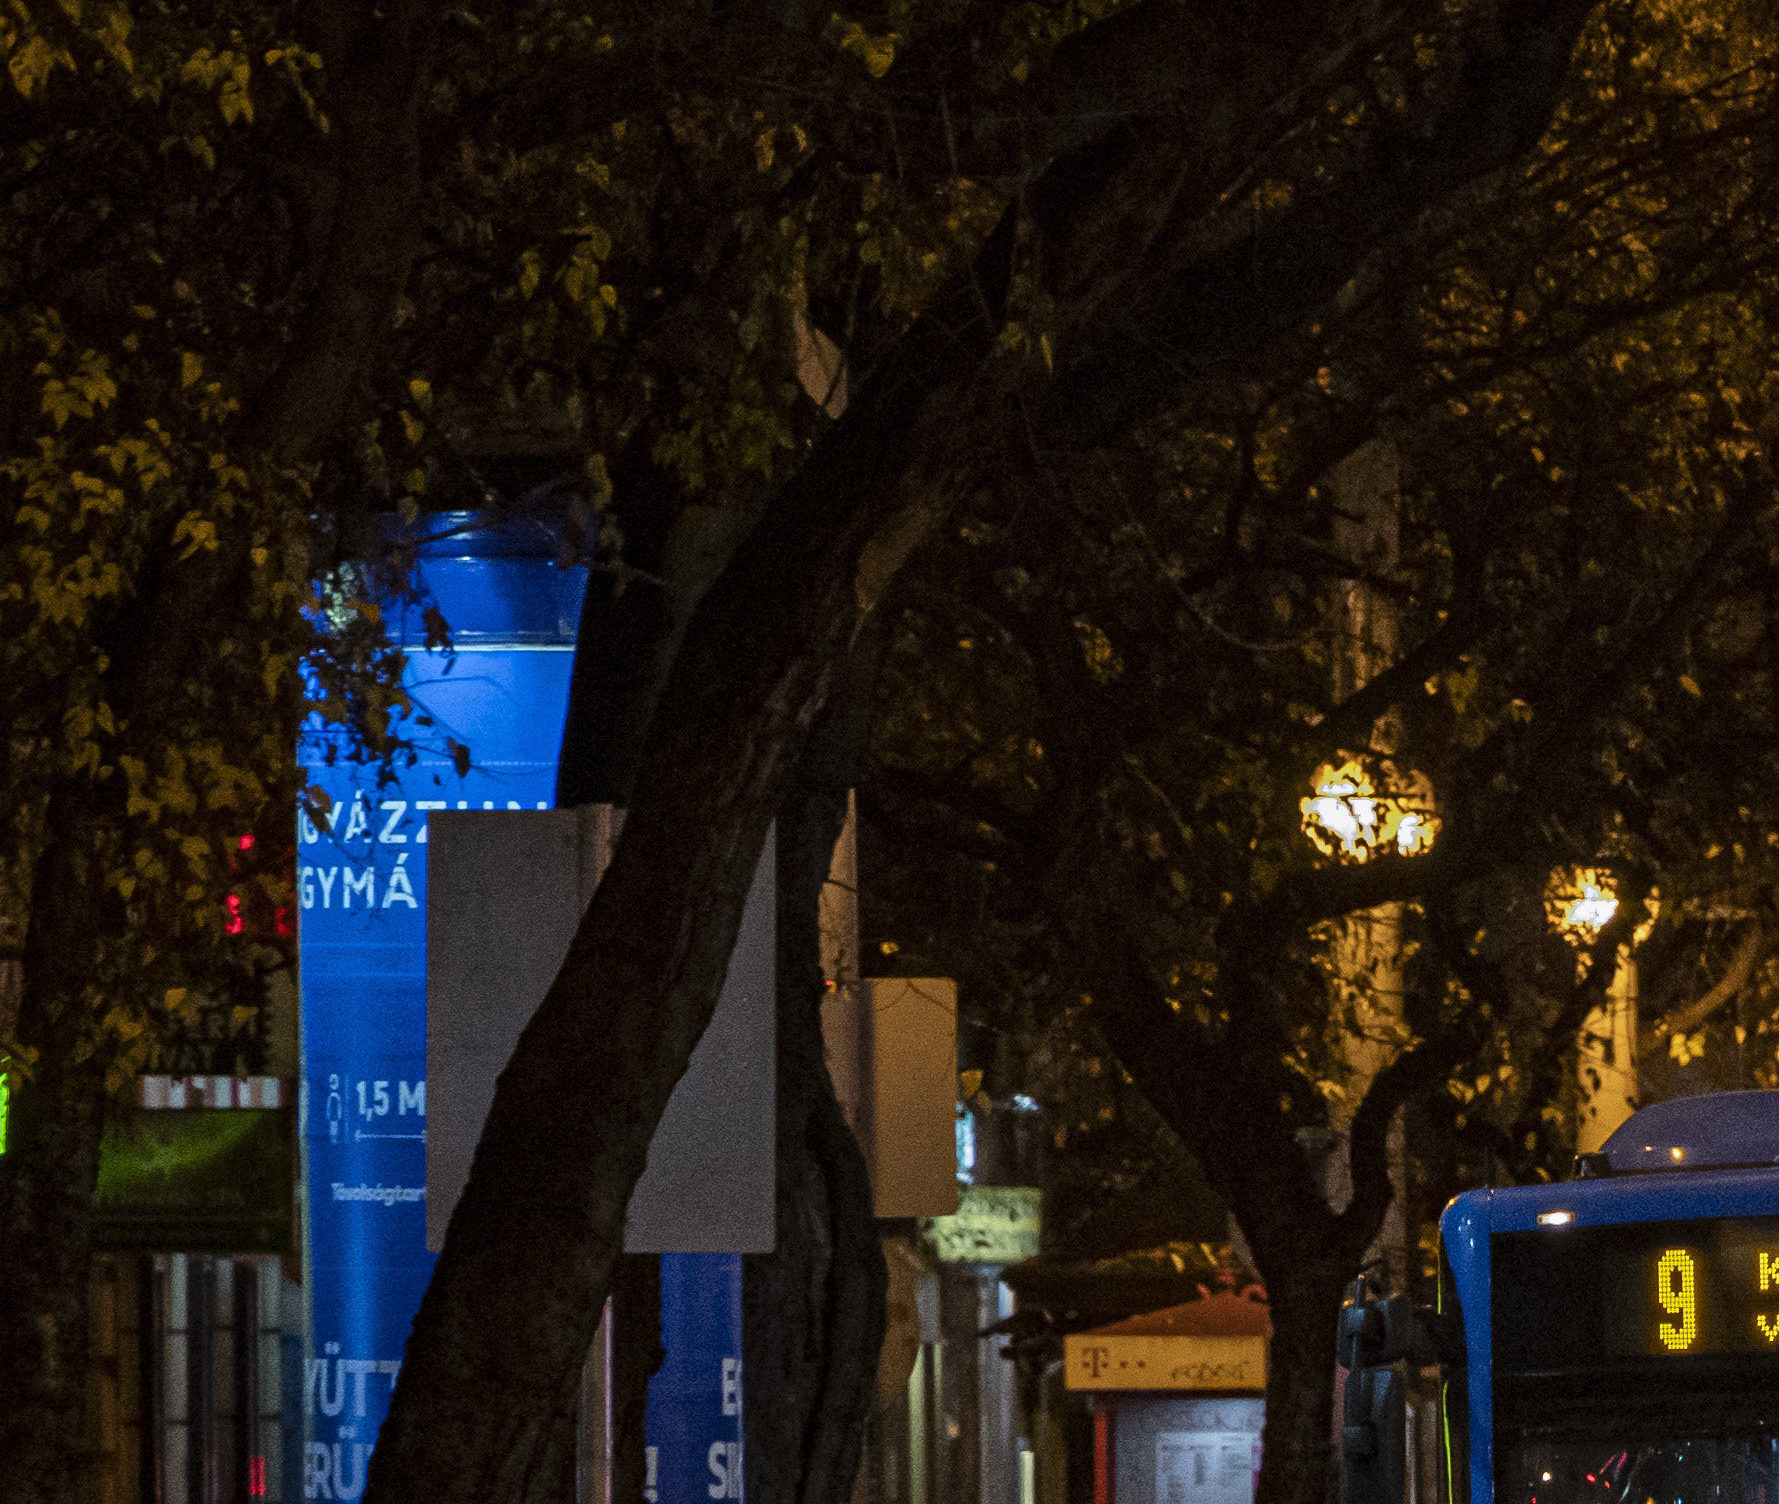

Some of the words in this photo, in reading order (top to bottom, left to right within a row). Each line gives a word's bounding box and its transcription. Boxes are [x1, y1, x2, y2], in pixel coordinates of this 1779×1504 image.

[356, 1080, 390, 1121] 1,5
[398, 1080, 427, 1116] M
[1657, 1249, 1697, 1350] 9
